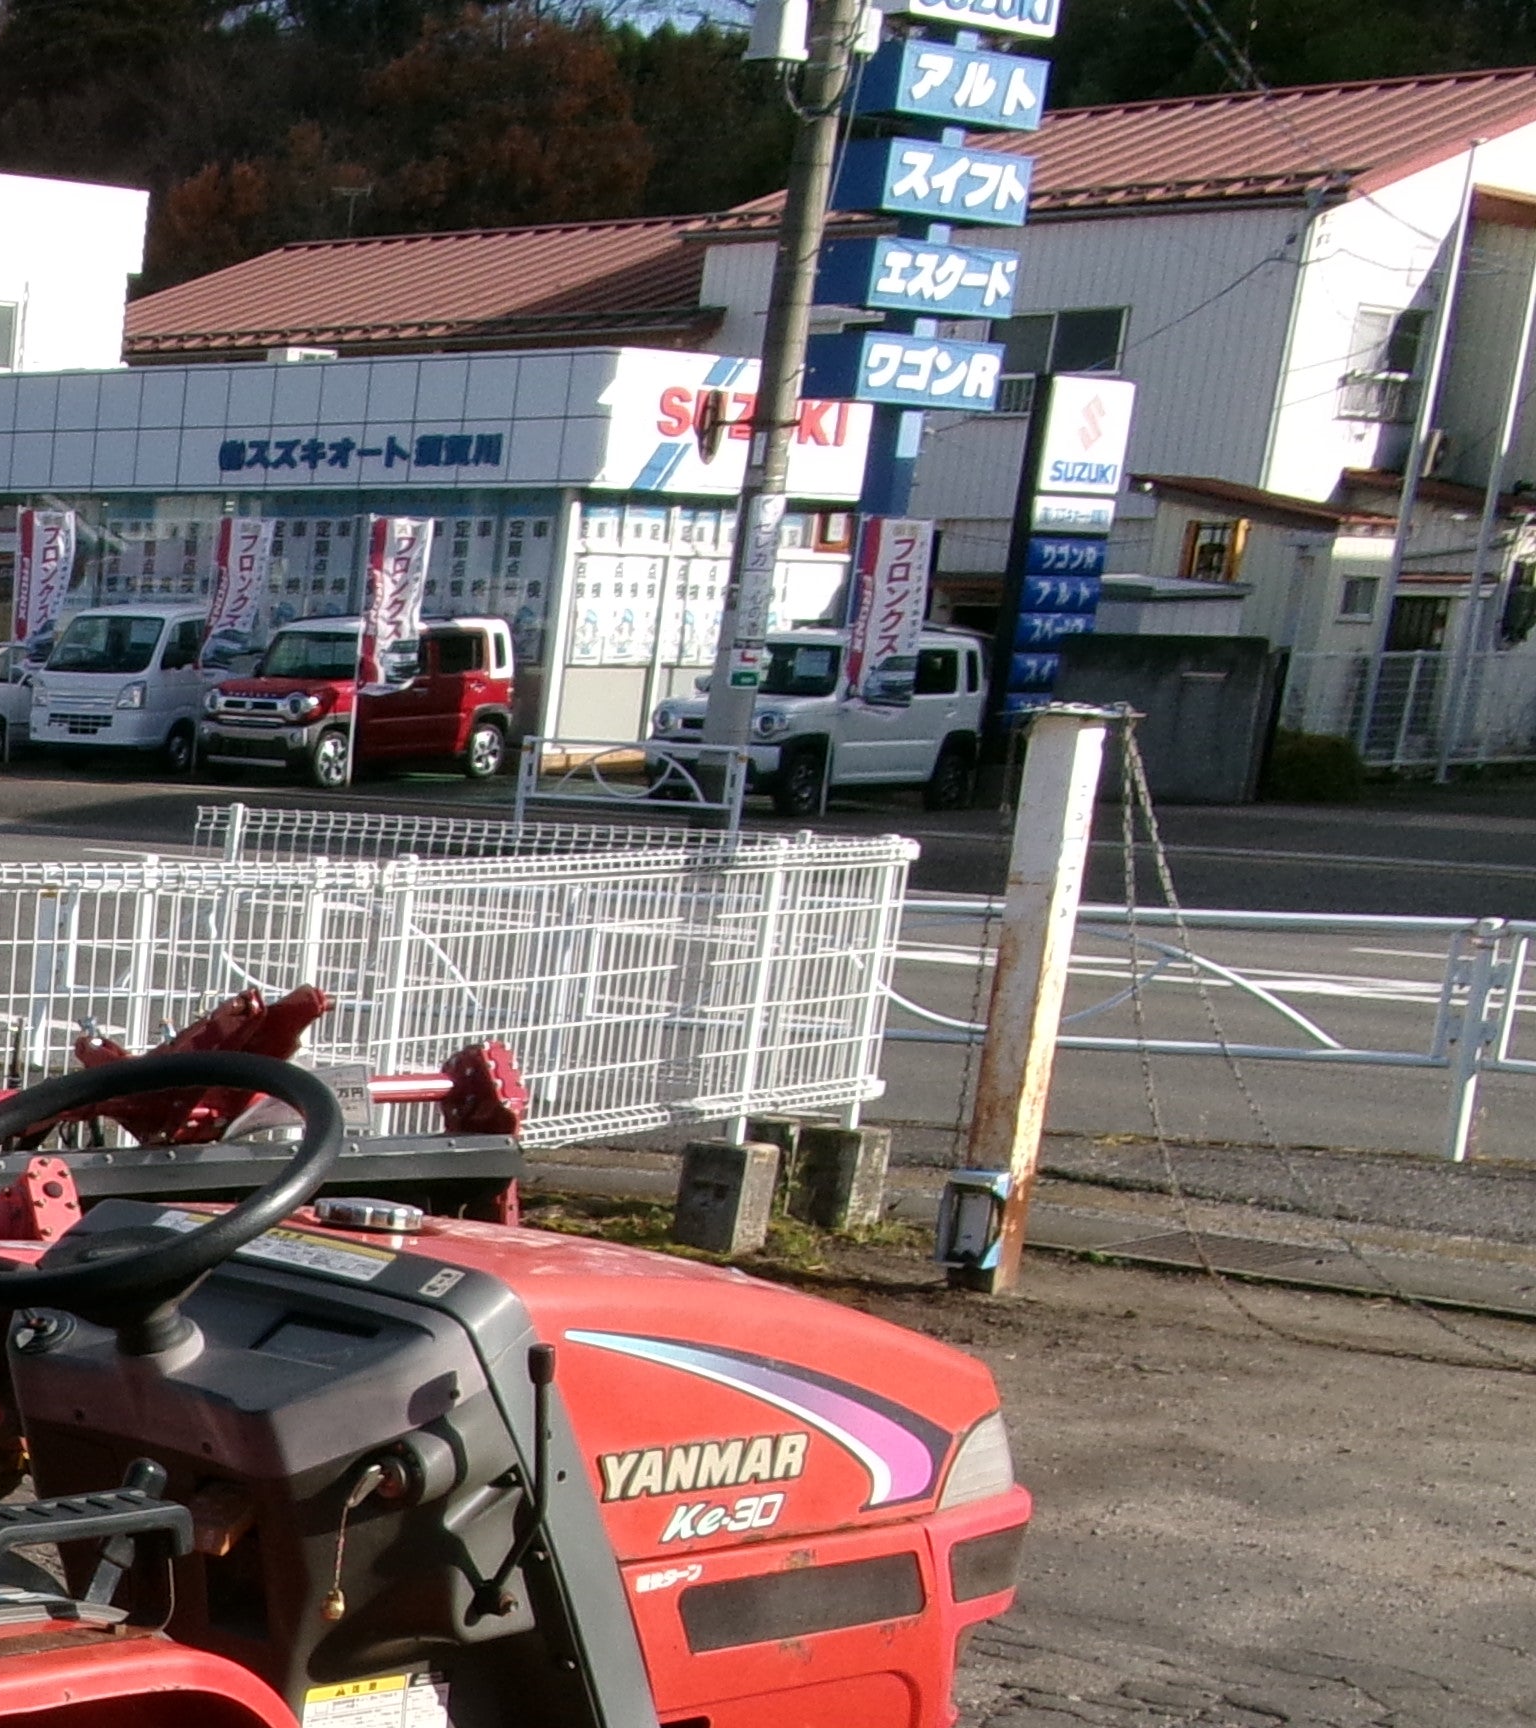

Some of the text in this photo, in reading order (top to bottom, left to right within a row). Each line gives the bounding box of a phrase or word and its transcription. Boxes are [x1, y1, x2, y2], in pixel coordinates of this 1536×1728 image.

[910, 52, 1037, 117] アルト
[893, 150, 1026, 210] スイフト
[876, 250, 1017, 306] エスクード
[865, 342, 1003, 399] ワゴンR
[656, 386, 850, 446] SZKI
[1049, 460, 1118, 484] SUZUKI
[875, 538, 917, 657] フロンクス
[336, 1086, 364, 1098] 万円
[597, 1432, 810, 1502] YANMAR
